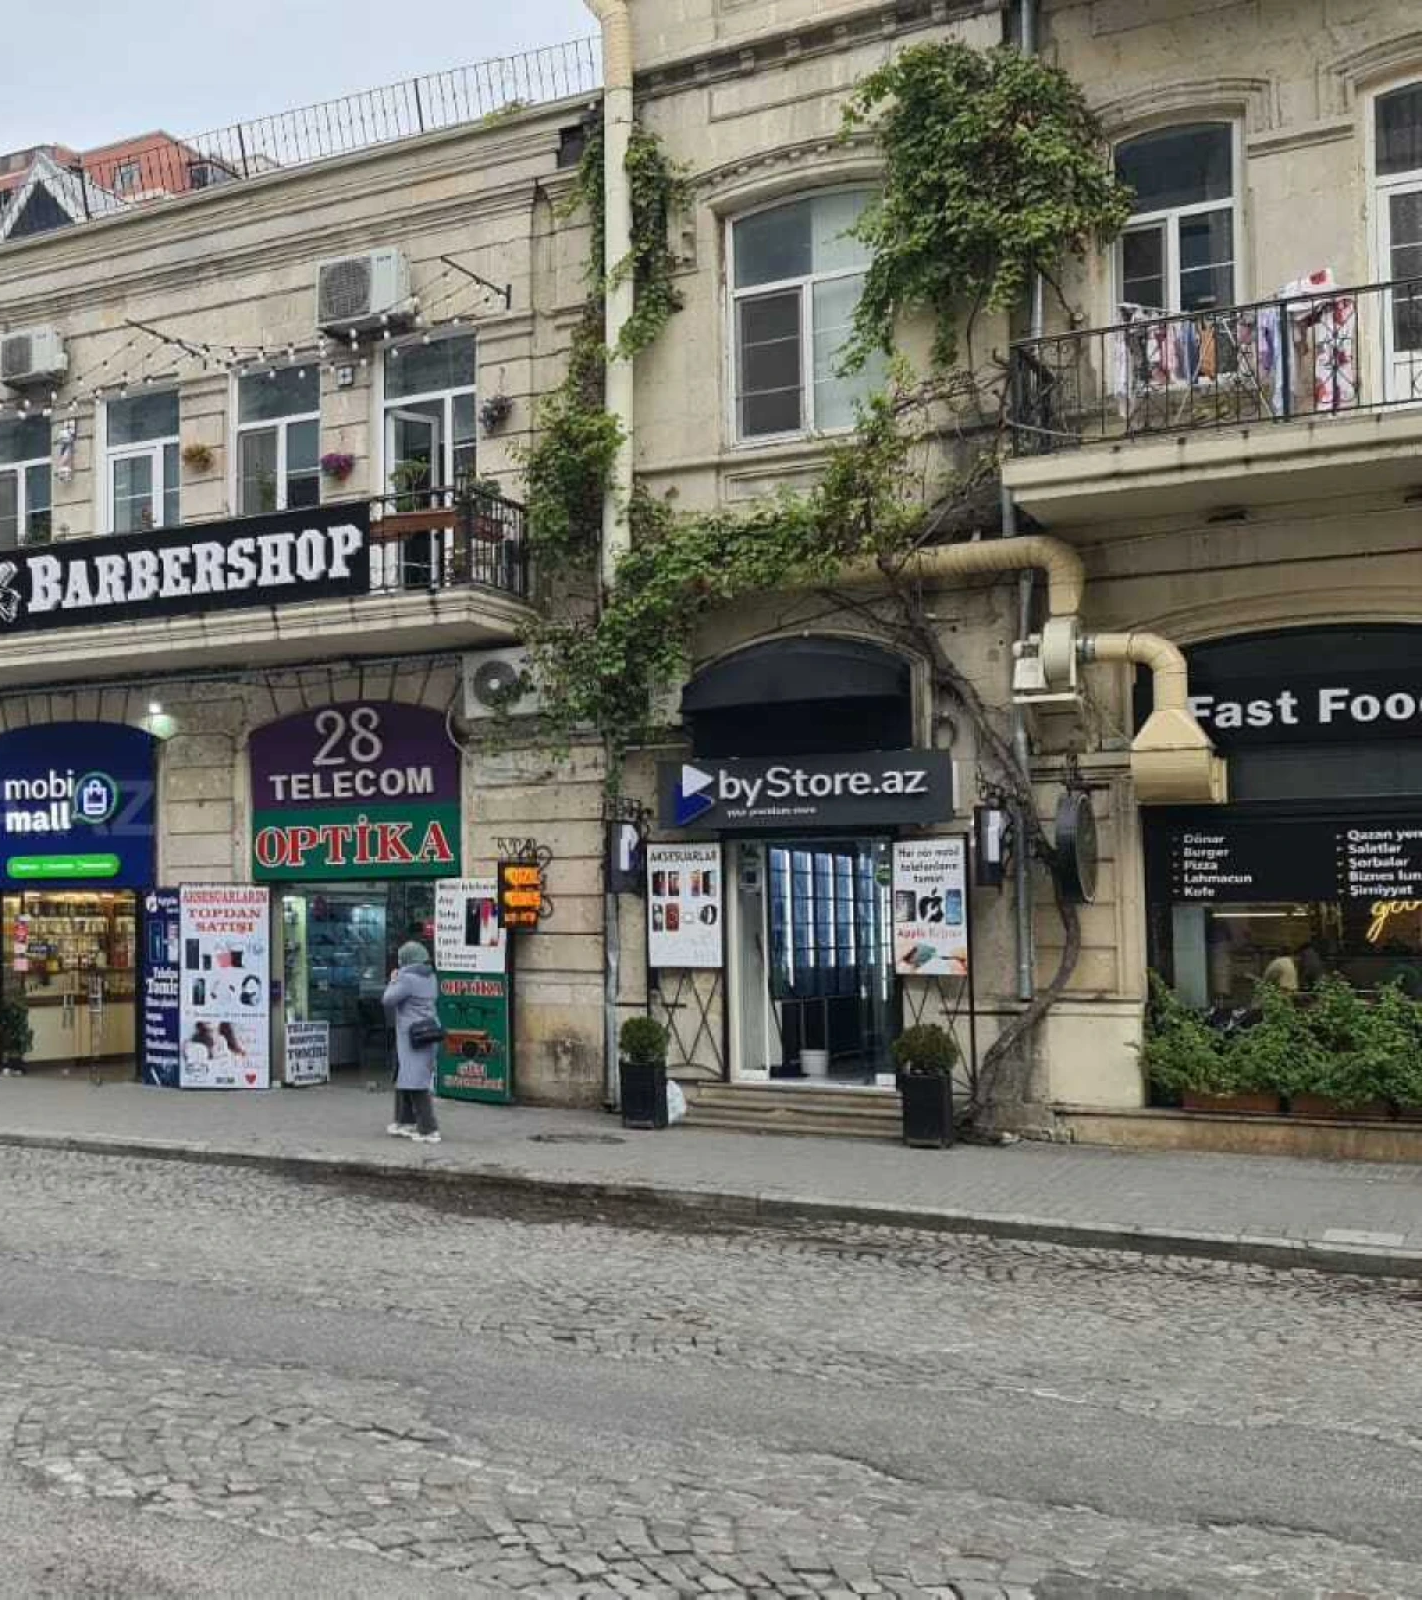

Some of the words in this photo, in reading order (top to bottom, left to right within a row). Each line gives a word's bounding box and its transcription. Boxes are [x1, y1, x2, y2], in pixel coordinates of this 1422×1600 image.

[27, 522, 364, 613] BARBERSHOP
[1187, 690, 1299, 728] Fast
[1318, 687, 1422, 724] Foo
[312, 706, 384, 767] 28
[4, 769, 75, 801] mobi
[269, 767, 434, 801] TELECOM
[718, 766, 928, 808] byStore.az
[5, 802, 73, 833] mall
[255, 813, 455, 868] OPTİKA
[1183, 872, 1253, 884] Lahmacun
[187, 906, 261, 918] TOPDAN
